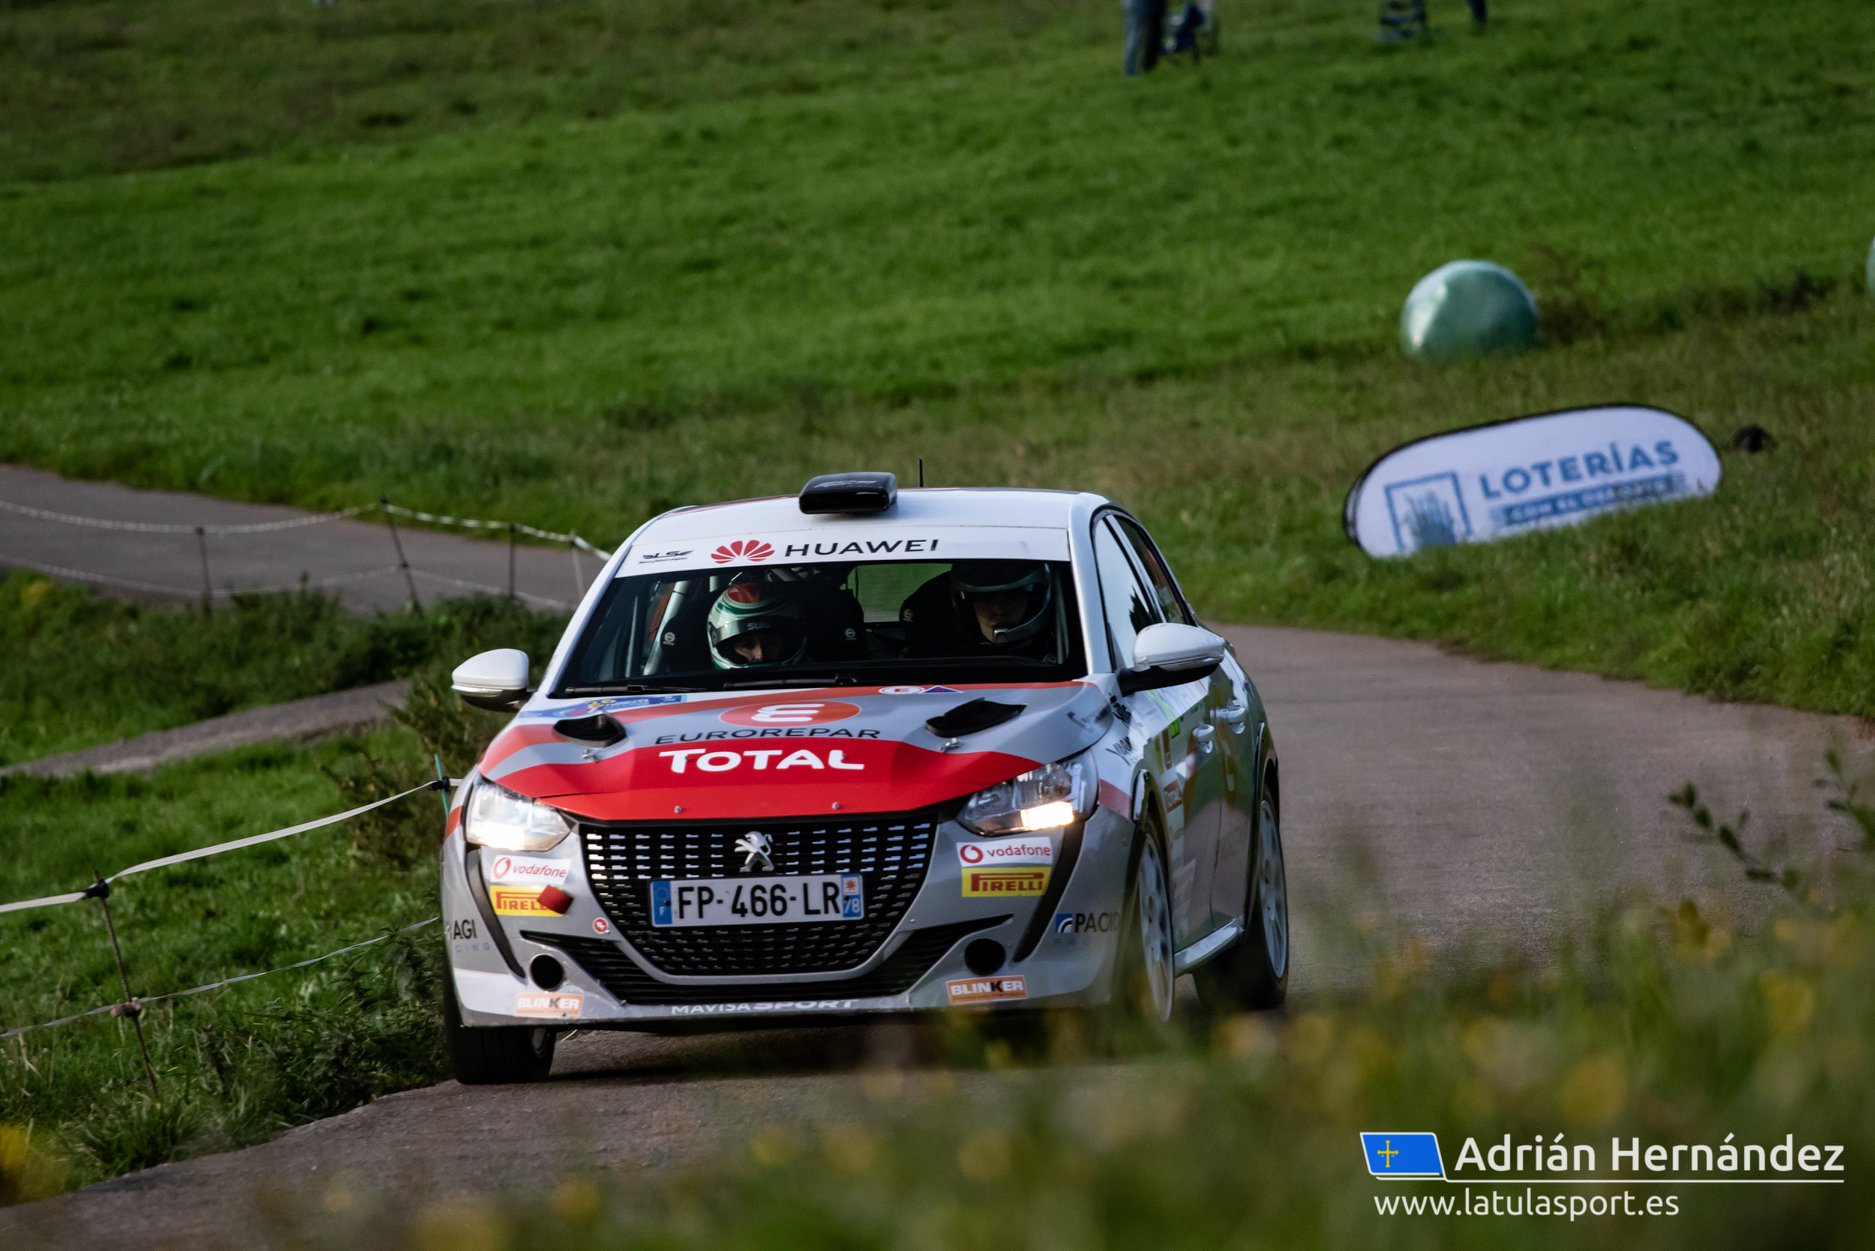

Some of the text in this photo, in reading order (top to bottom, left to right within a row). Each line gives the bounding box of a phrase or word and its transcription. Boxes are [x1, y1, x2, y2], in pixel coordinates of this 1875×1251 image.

[1479, 440, 1680, 499] LOTERÍAS
[784, 539, 938, 557] HUAWEI
[655, 728, 881, 745] EUROREPAR
[658, 748, 865, 773] TOTAL
[987, 844, 1051, 857] vodafone
[512, 865, 567, 878] vodafone
[971, 872, 1044, 891] PIRELLI
[496, 891, 549, 910] PIRELL
[843, 898, 860, 914] 78
[951, 981, 1024, 996] BLINKER
[517, 998, 580, 1009] BLINKER
